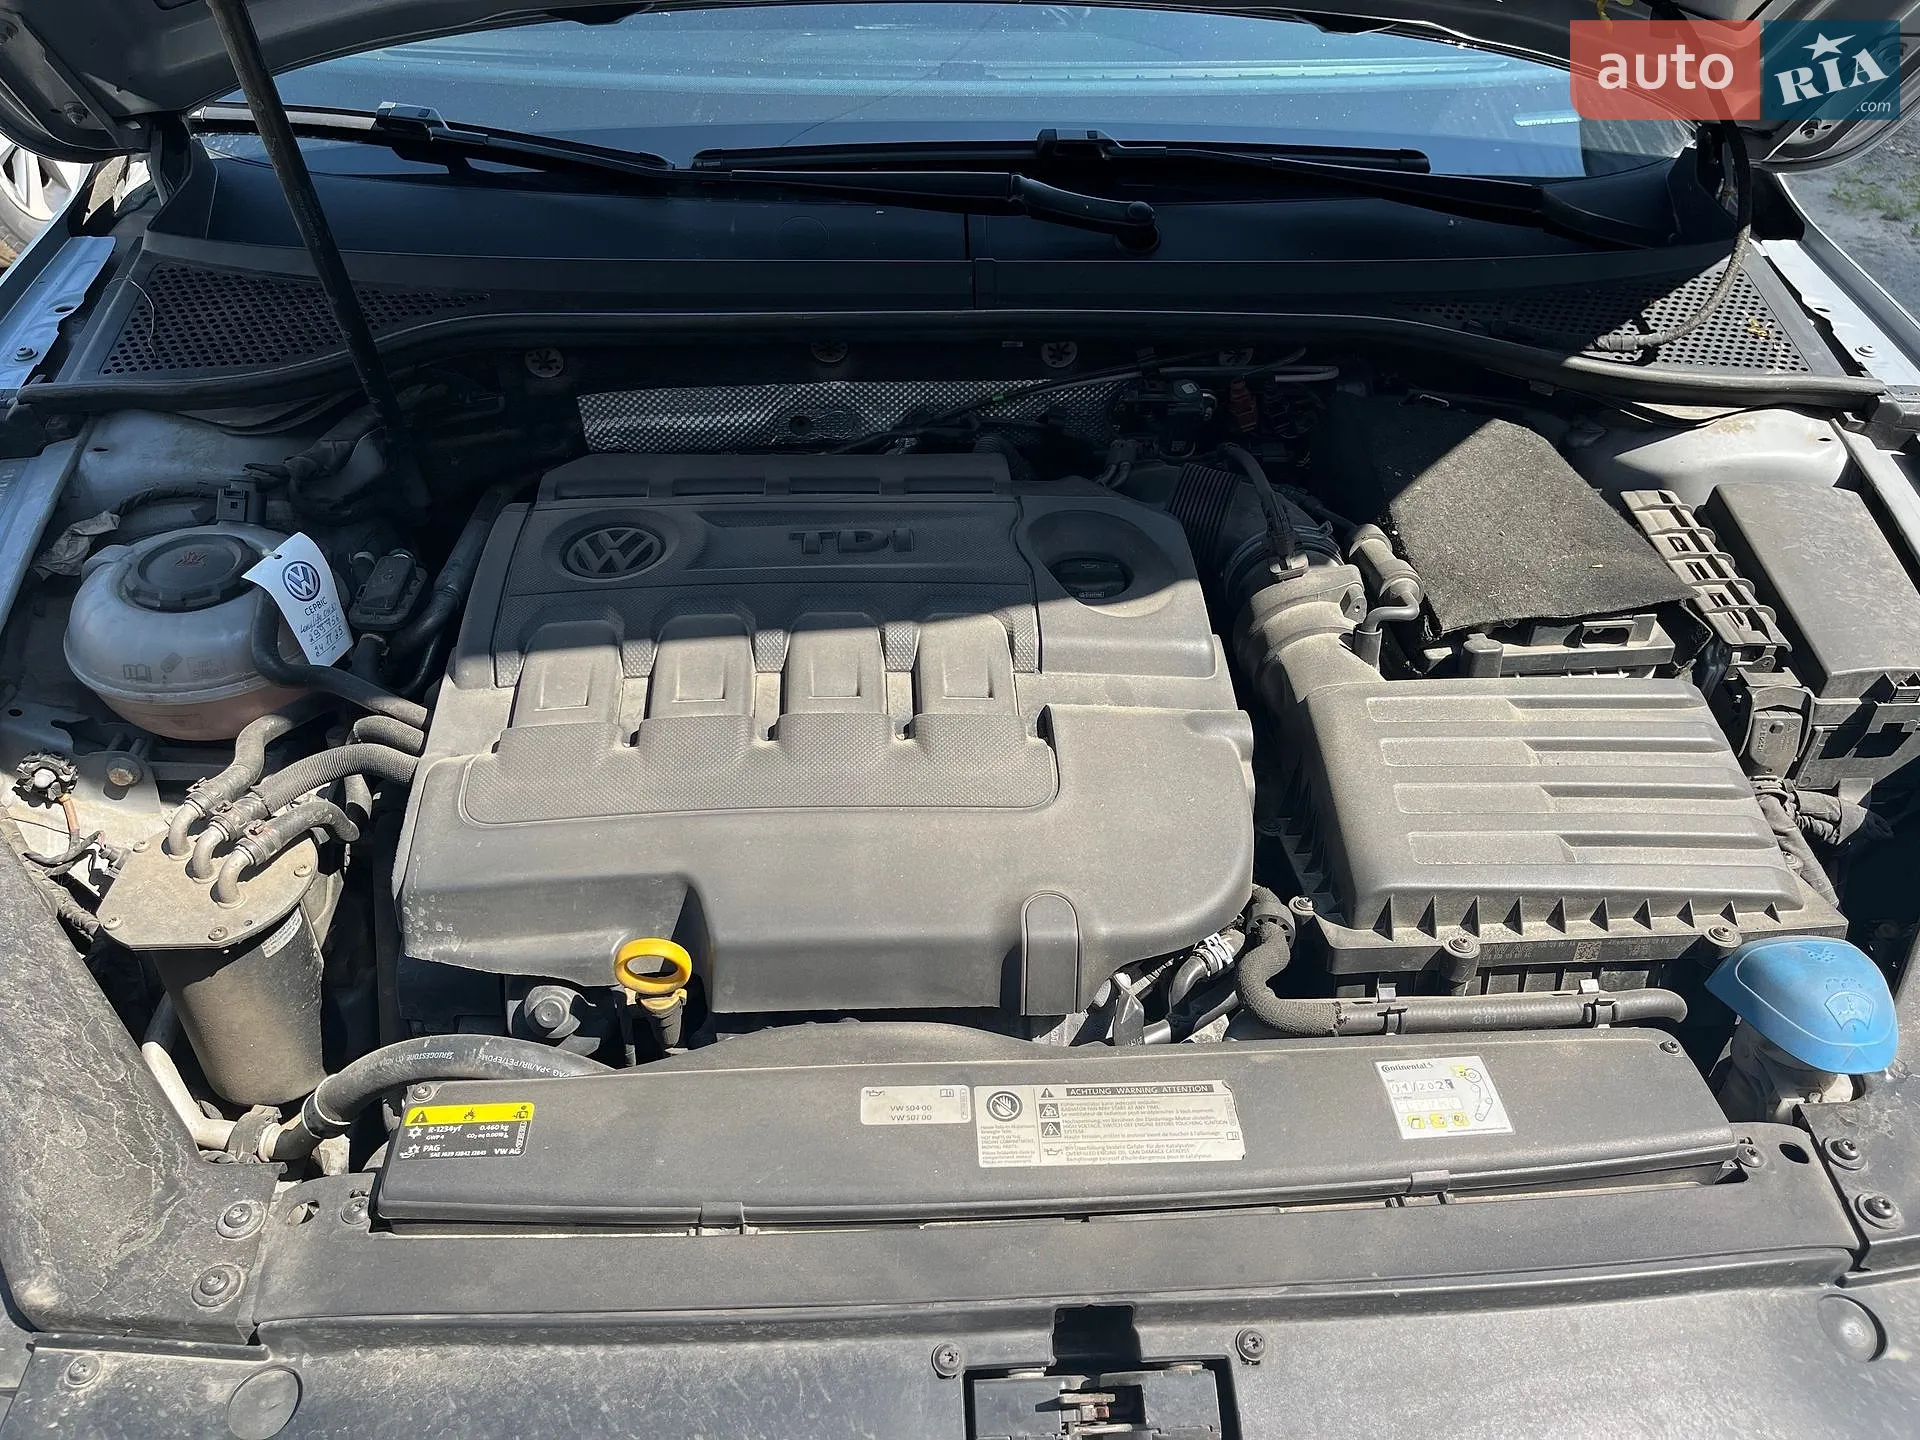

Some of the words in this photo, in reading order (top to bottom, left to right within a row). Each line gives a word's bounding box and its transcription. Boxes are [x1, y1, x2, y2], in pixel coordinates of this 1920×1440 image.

[788, 528, 914, 555] TDI
[1070, 1087, 1112, 1096] ACHTUNG
[1116, 1086, 1158, 1094] WARNING
[1161, 1085, 1208, 1093] ATTENTION
[428, 1124, 464, 1134] R-1234yf
[501, 1123, 510, 1131] kg
[422, 1144, 440, 1152] PAG
[508, 1147, 521, 1155] AG
